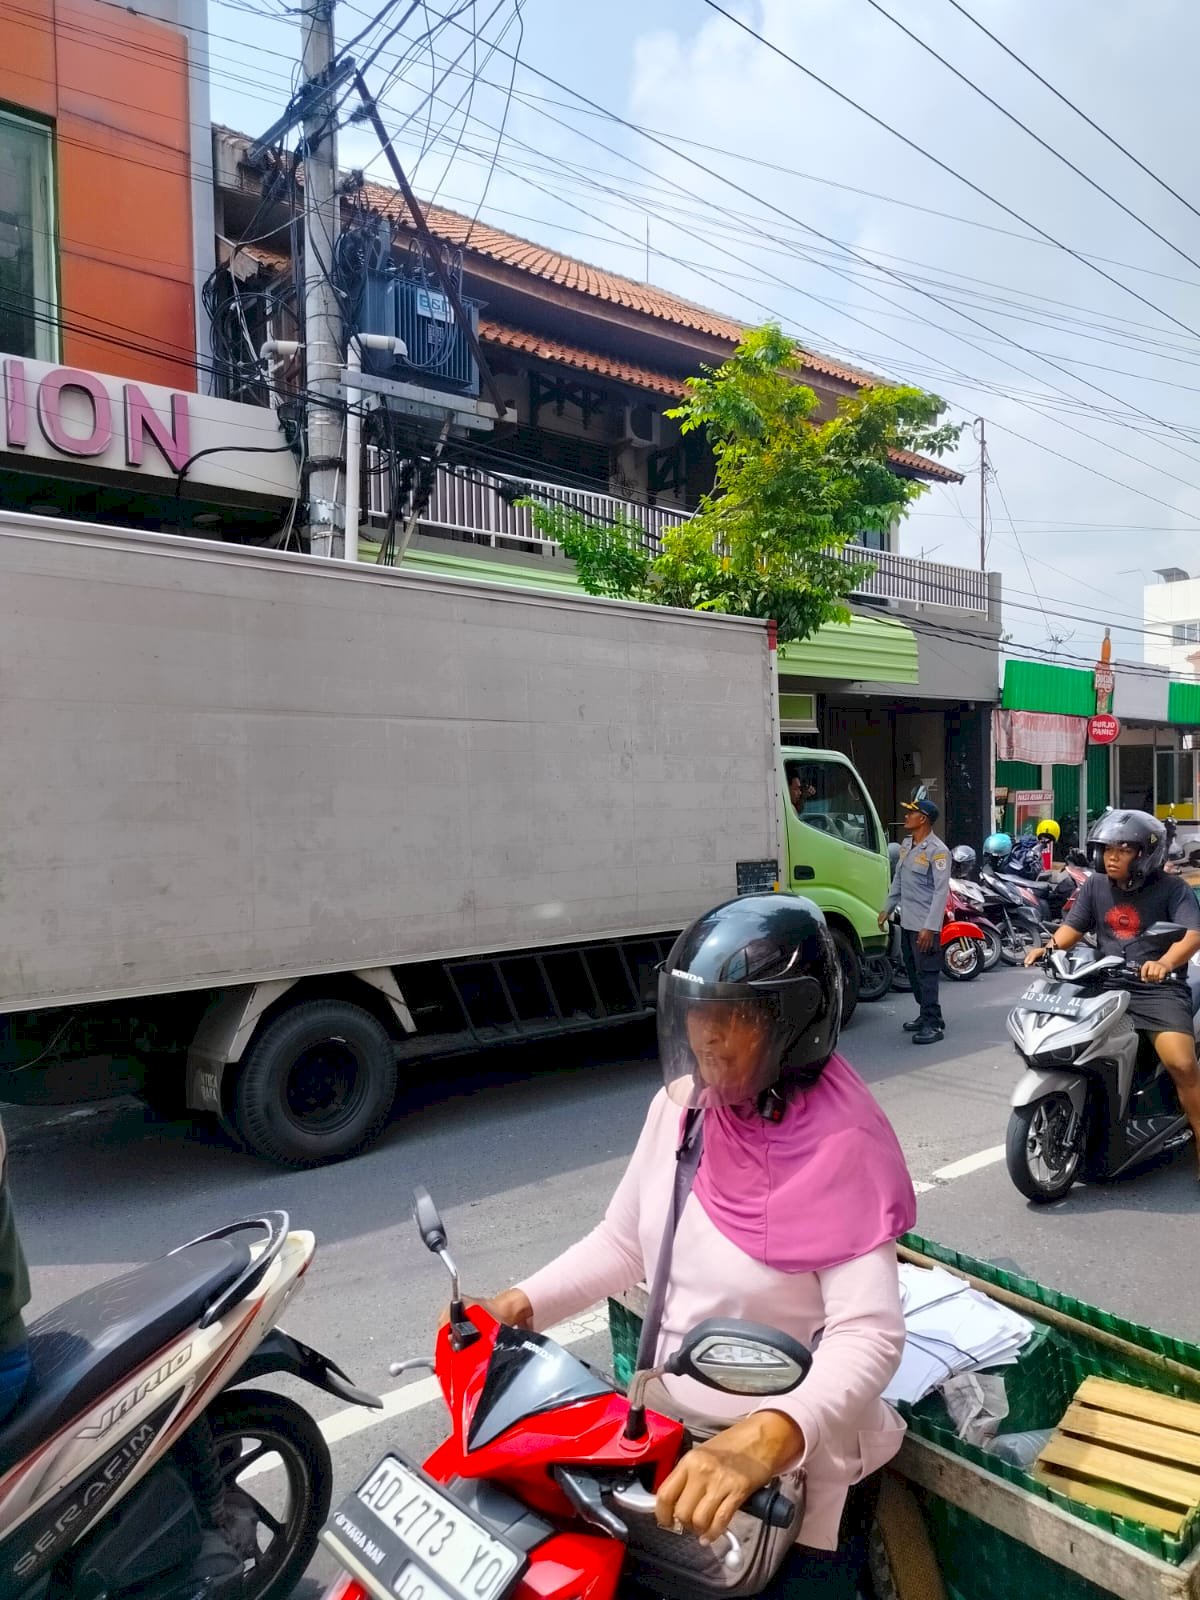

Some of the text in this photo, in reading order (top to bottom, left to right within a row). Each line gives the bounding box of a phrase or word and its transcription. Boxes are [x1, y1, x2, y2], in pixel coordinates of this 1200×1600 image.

[3, 359, 191, 475] ION
[1092, 728, 1115, 736] PANIC
[671, 969, 704, 984] HONDA
[1021, 991, 1036, 1001] AD
[74, 1343, 194, 1440] VARIO
[13, 1423, 154, 1576] SERAFIM
[361, 1469, 403, 1511] AD
[393, 1494, 457, 1557] 4773
